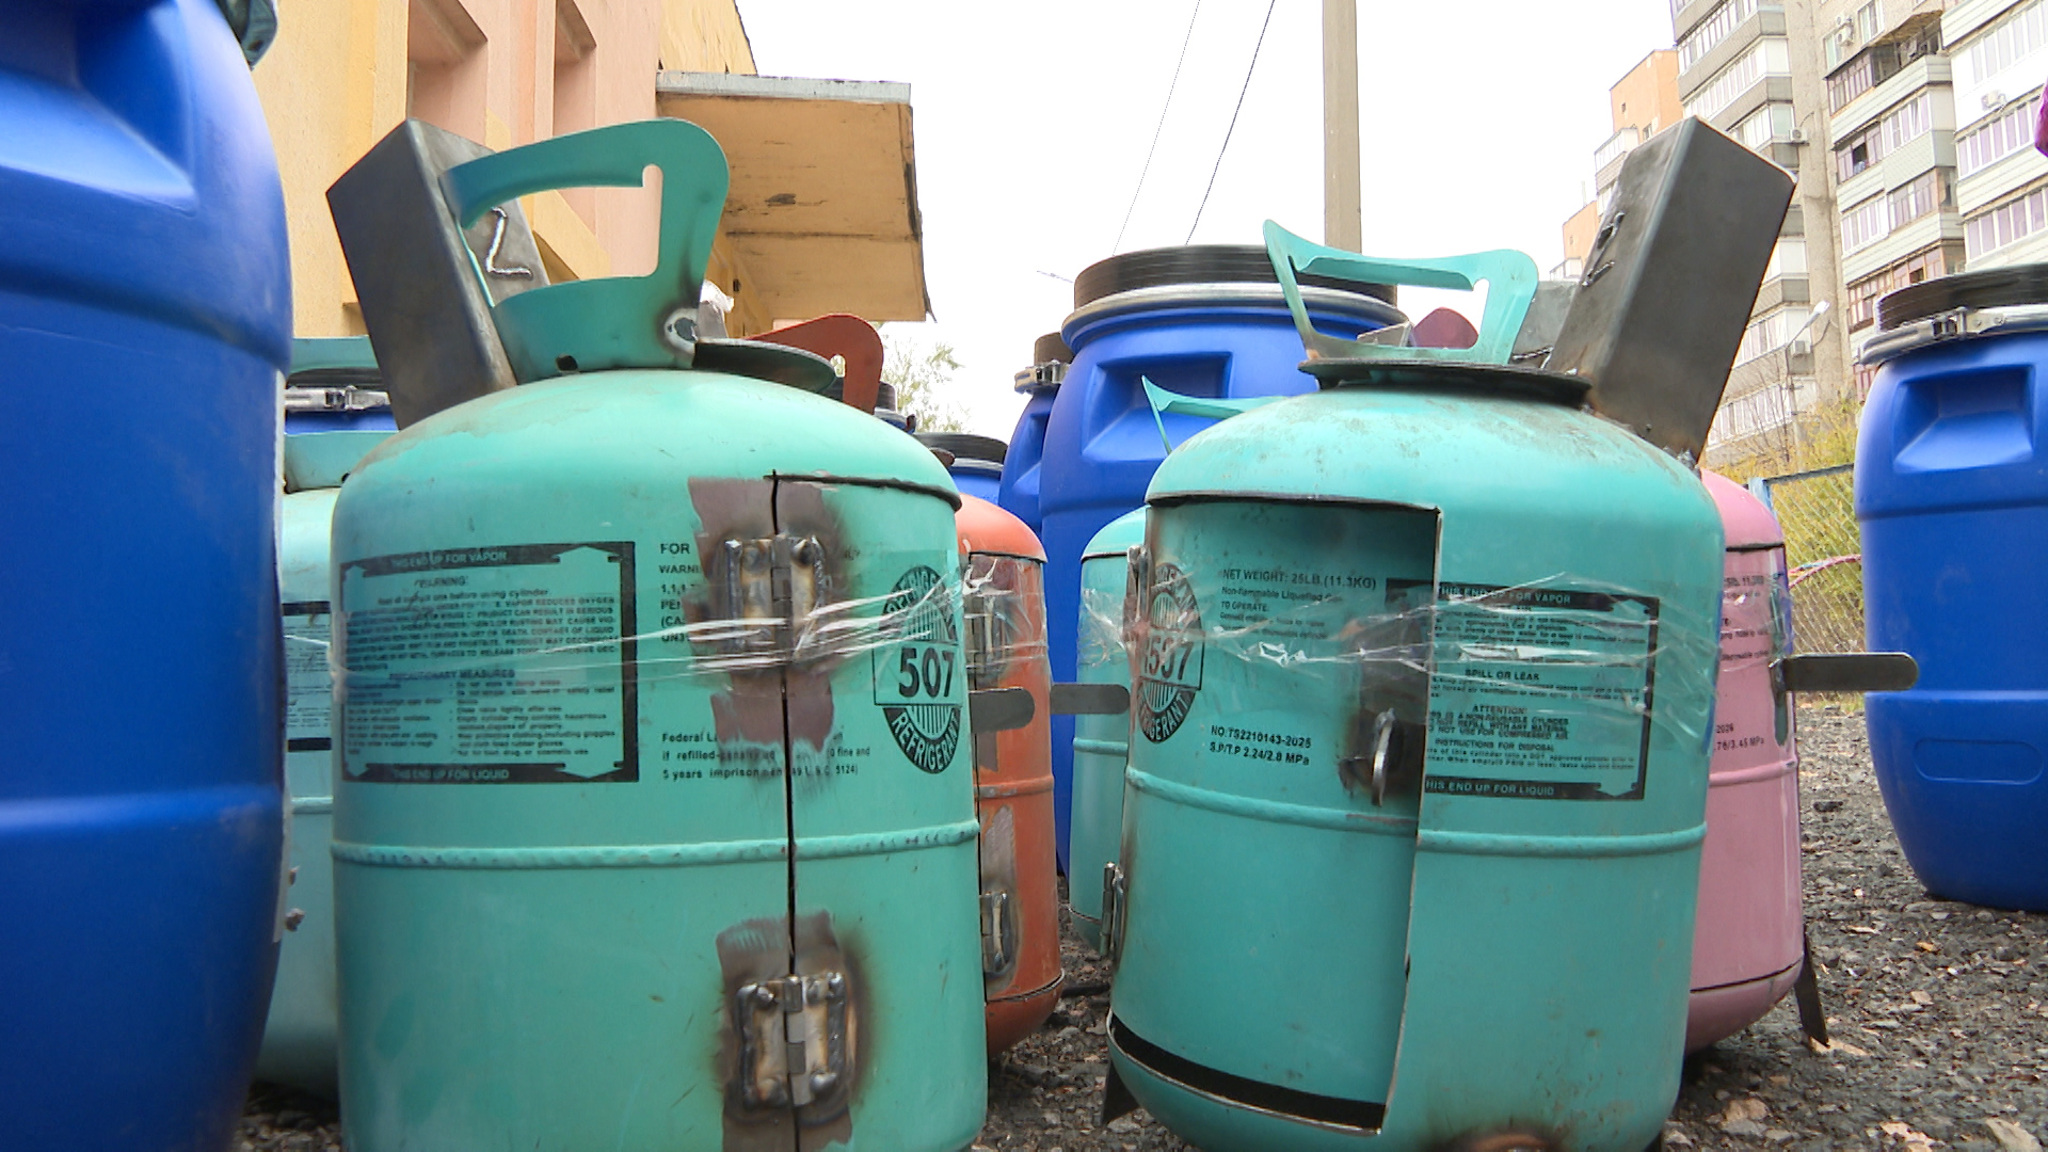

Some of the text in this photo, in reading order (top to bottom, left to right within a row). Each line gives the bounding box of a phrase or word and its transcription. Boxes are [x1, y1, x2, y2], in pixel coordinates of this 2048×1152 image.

[660, 543, 691, 555] FOR
[445, 554, 467, 564] FOR
[468, 551, 507, 563] VAPOR
[1221, 569, 1241, 581] NET
[1509, 592, 1532, 602] FOR
[1535, 593, 1571, 604] VAPOR
[898, 646, 956, 699] 507
[1465, 668, 1540, 682] SPILL OR LEAK
[661, 732, 704, 743] Federal
[837, 748, 854, 758] fine
[856, 748, 871, 757] and
[1285, 752, 1311, 767] MPa
[413, 769, 431, 781] END
[432, 769, 446, 781] UP
[448, 769, 471, 780] FOR
[472, 768, 510, 781] LIQUID
[672, 769, 703, 782] years
[1448, 780, 1473, 792] END
[1475, 781, 1491, 793] UP
[1493, 782, 1517, 794] FOR
[1519, 783, 1555, 797] LIQUID
